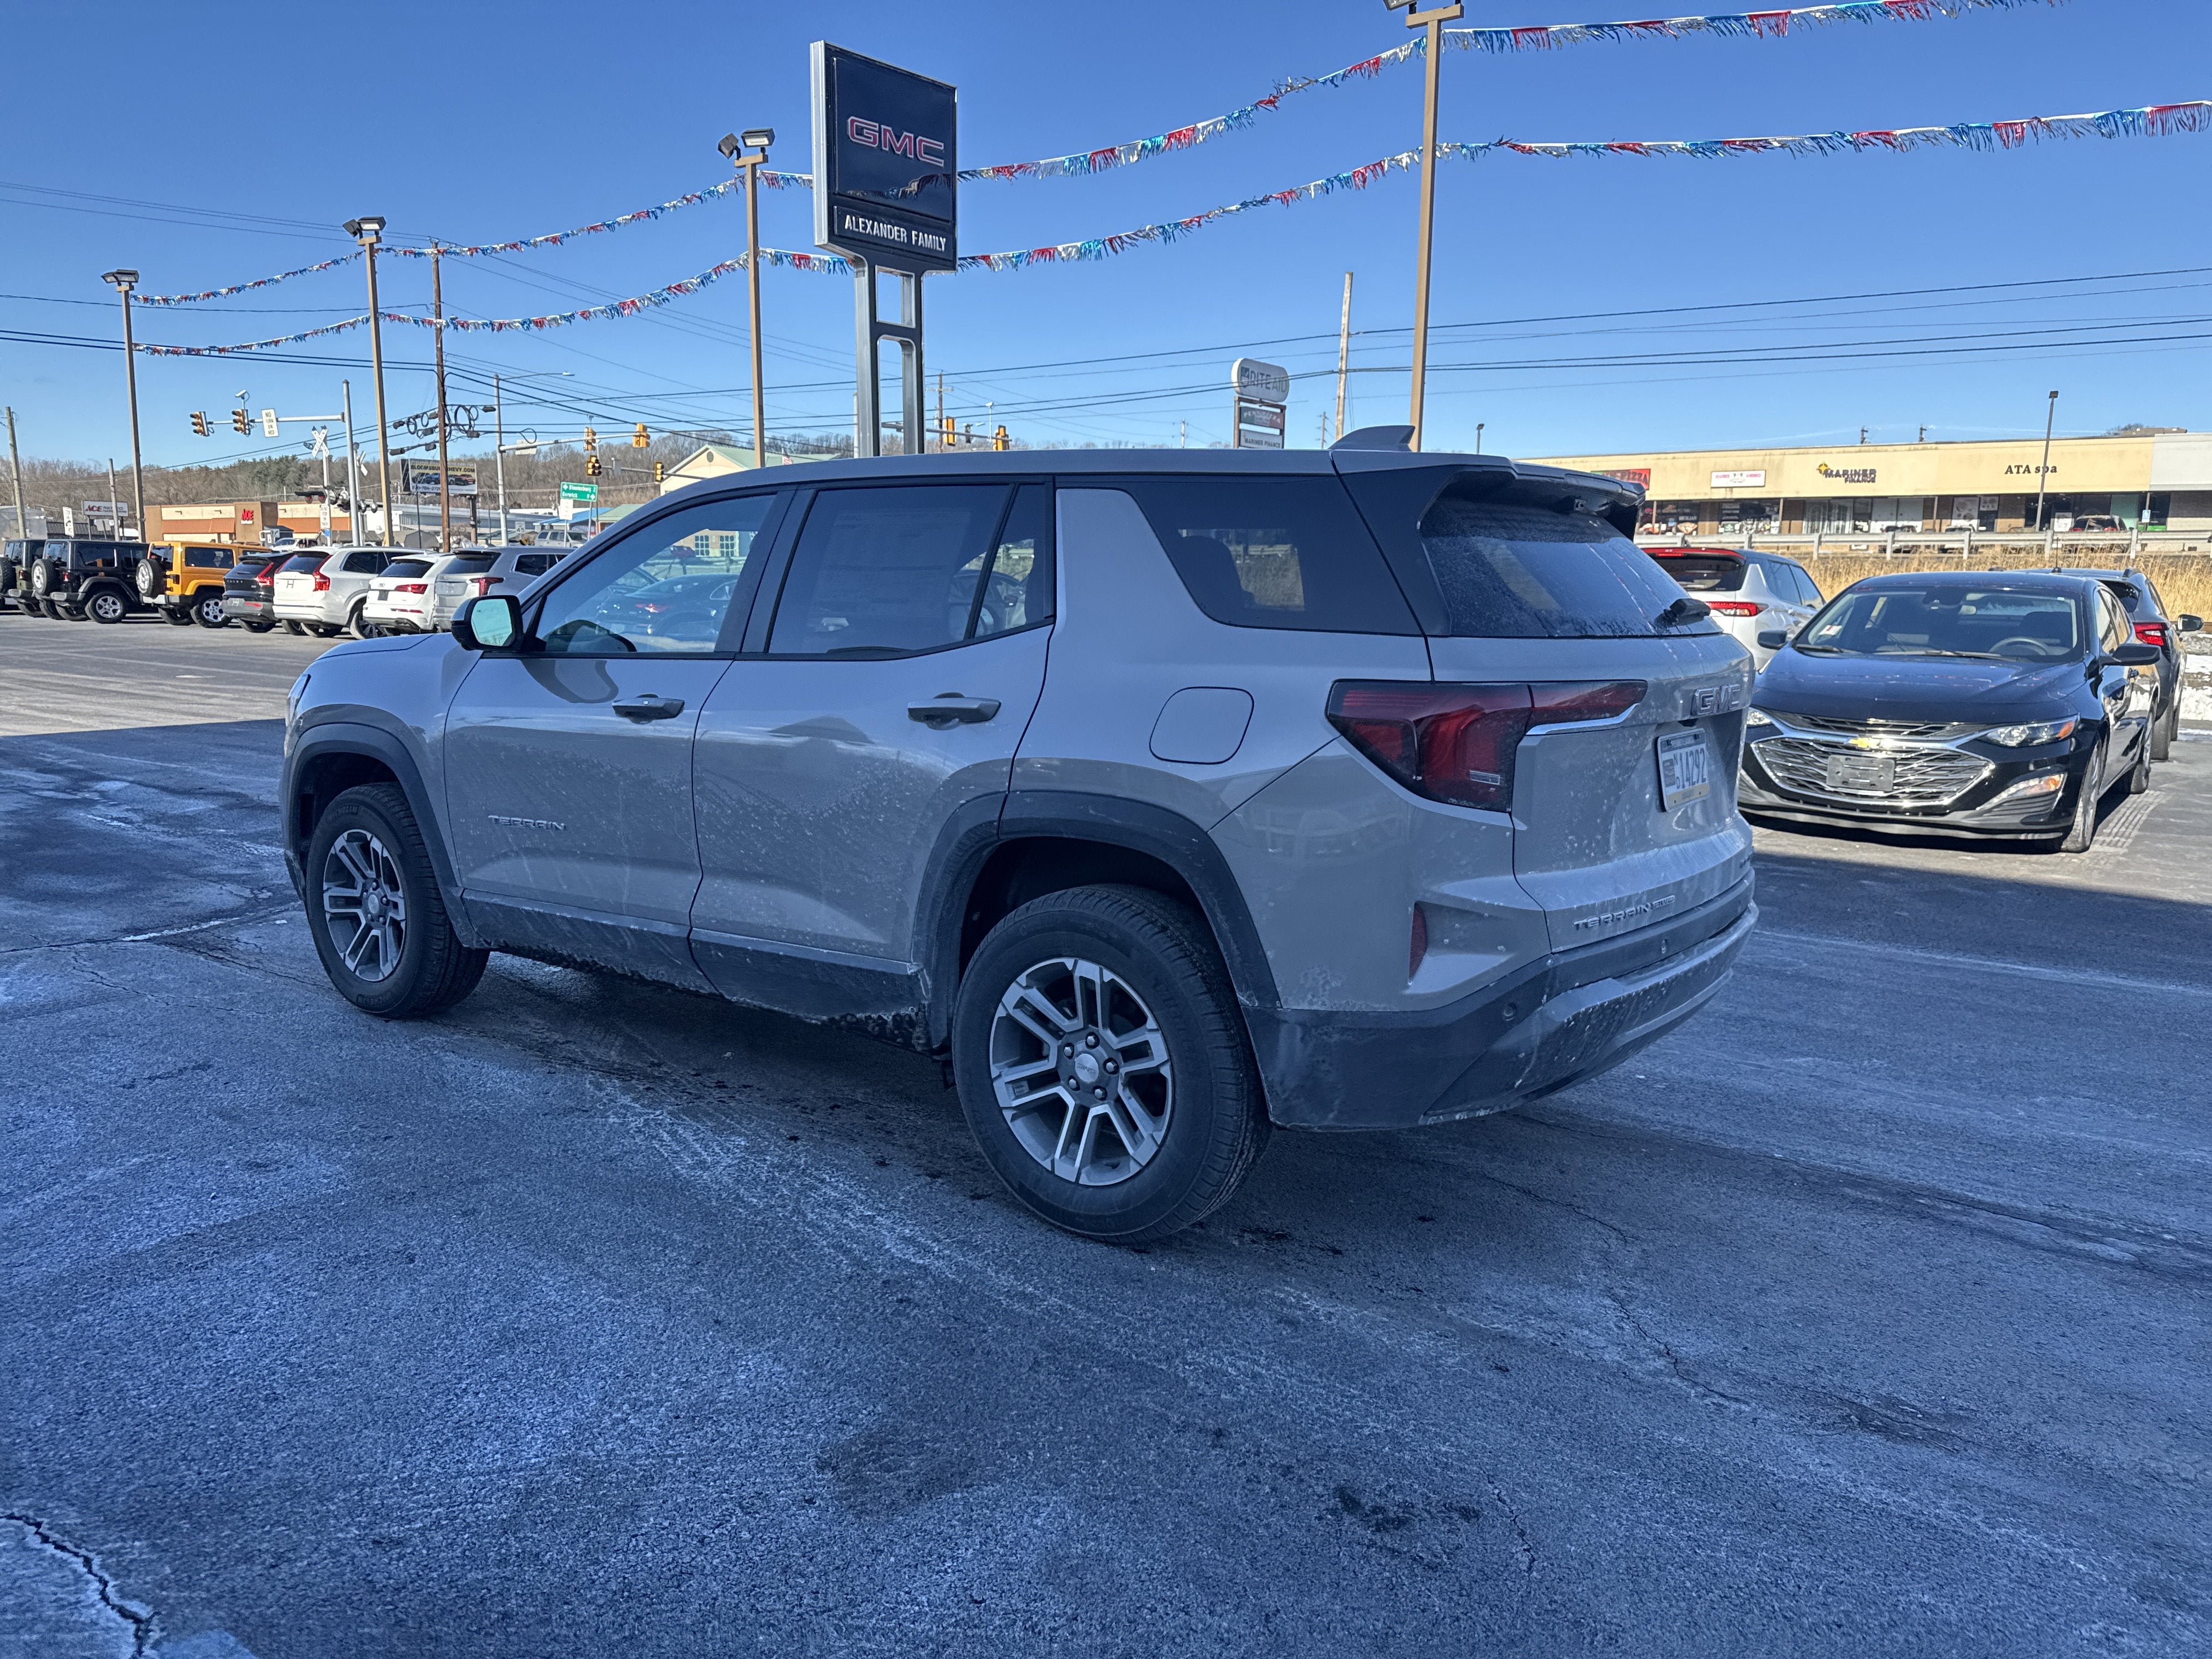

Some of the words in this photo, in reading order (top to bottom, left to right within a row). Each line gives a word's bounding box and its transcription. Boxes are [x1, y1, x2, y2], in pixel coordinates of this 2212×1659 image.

[848, 116, 944, 167] GMC
[845, 215, 907, 244] ALEXANDER
[912, 230, 946, 252] FAMILY
[1250, 370, 1271, 390] RITE
[1272, 377, 1287, 393] AID
[1264, 440, 1281, 448] FINANCE
[1824, 469, 1876, 478] MARINER
[2004, 465, 2031, 475] ATA
[2034, 466, 2057, 477] spa
[569, 484, 591, 493] Bloomsburg
[241, 509, 253, 521] ACE
[1694, 684, 1741, 715] GMC
[1679, 747, 1707, 789] 14292
[488, 815, 567, 831] TERRAIN
[1573, 902, 1651, 930] TERRAIN
[1077, 1063, 1096, 1074] GMC
